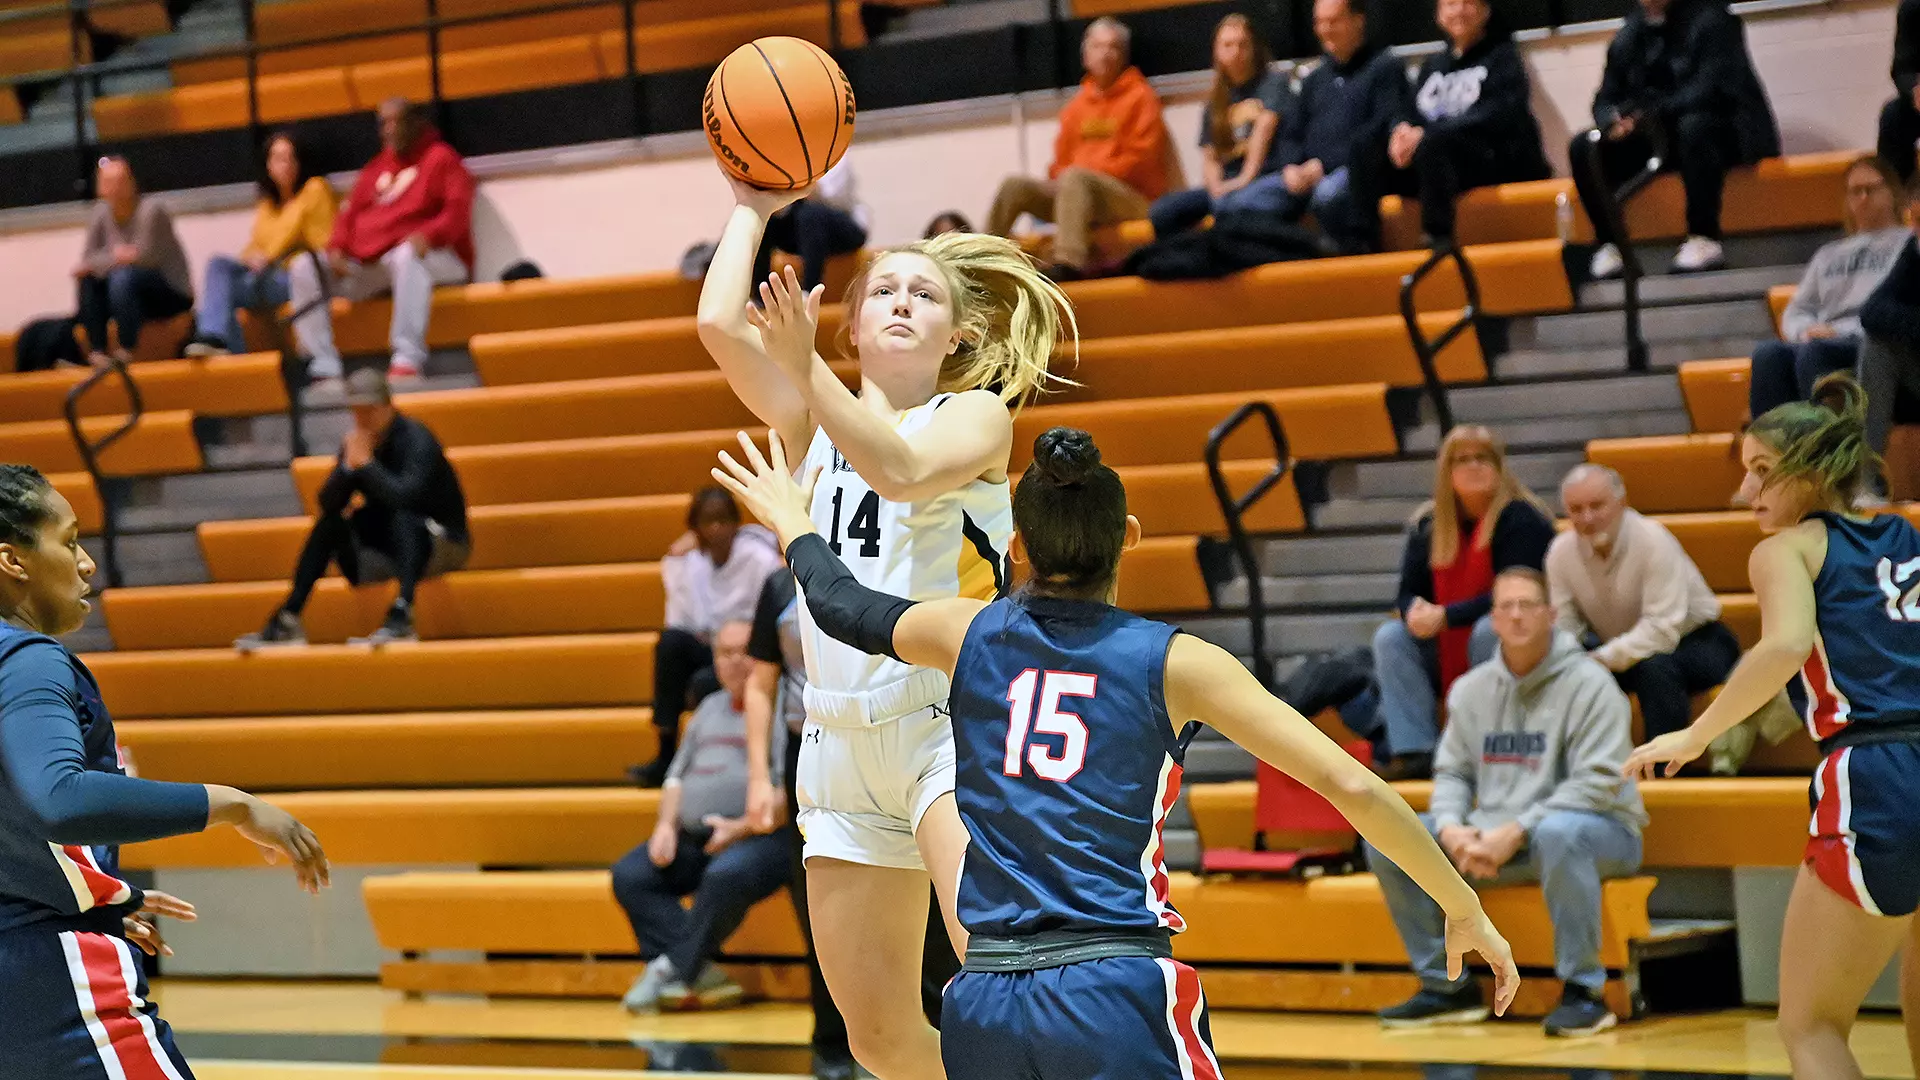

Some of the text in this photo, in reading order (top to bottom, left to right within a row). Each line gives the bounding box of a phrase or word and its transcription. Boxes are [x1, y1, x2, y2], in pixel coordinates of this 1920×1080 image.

[704, 77, 750, 174] Wilson
[828, 485, 881, 558] 14
[1003, 667, 1098, 783] 15
